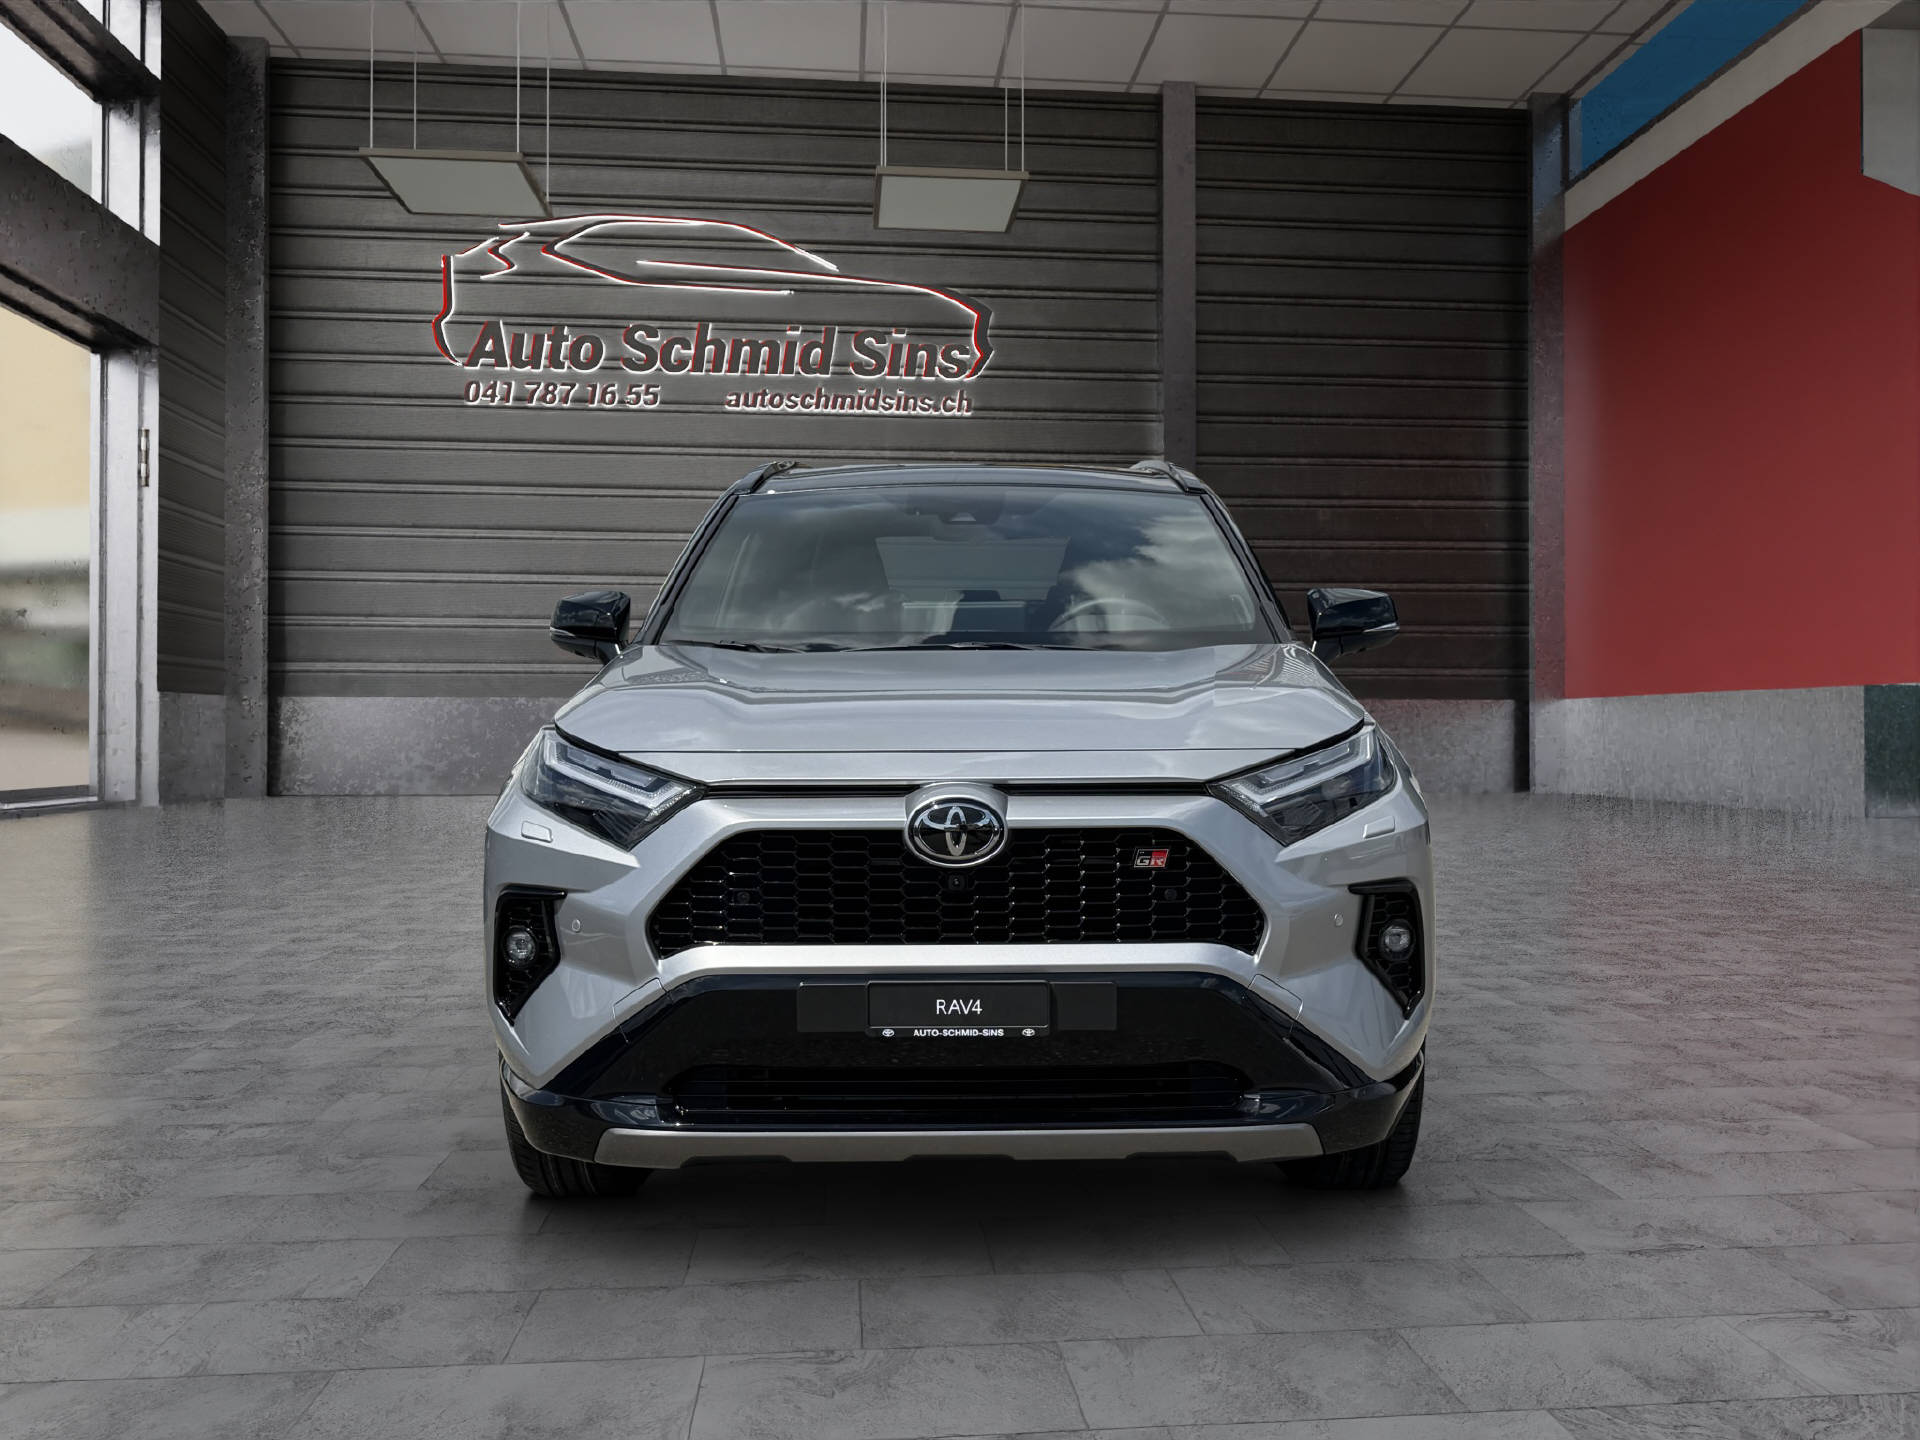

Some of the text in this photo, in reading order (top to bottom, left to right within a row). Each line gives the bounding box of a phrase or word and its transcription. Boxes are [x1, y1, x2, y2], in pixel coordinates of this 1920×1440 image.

[465, 320, 970, 380] Auto Schmid Sins
[464, 380, 661, 407] 041 787 16 55
[725, 387, 972, 416] autoschmidsins.ch
[1136, 855, 1165, 866] GR
[936, 999, 983, 1015] RAV4
[913, 1029, 1004, 1037] AUTO-SCHMID-SINS
